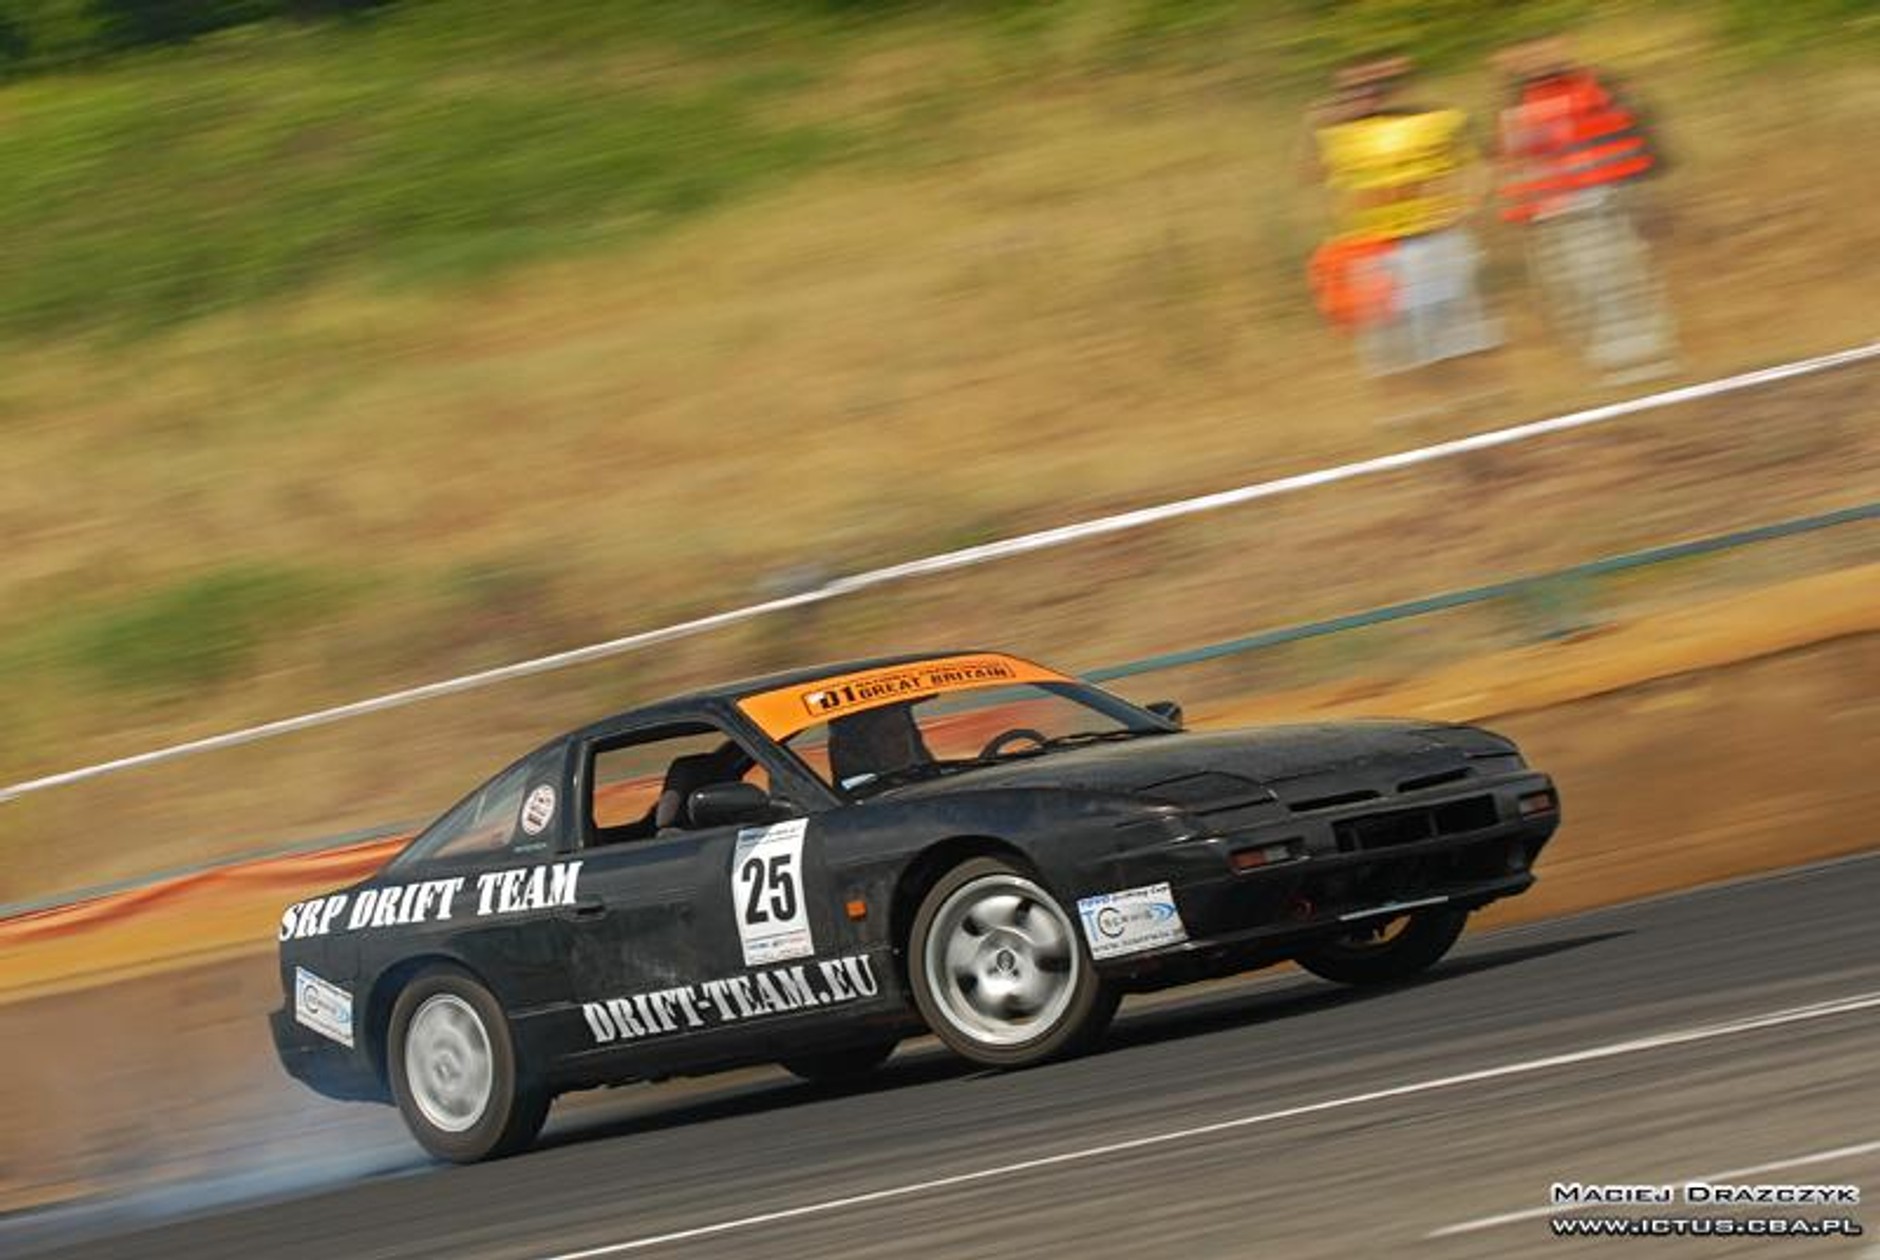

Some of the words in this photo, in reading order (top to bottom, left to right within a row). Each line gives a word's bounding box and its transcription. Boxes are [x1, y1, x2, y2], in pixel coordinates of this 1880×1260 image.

[859, 676, 920, 700] GREAT
[930, 665, 1008, 686] BRITAIN
[279, 894, 347, 941] SRP
[347, 877, 465, 930] DRIFT
[477, 861, 583, 916] TEAM
[741, 853, 796, 925] 25
[583, 954, 878, 1043] DRIFT-TEAM.EU
